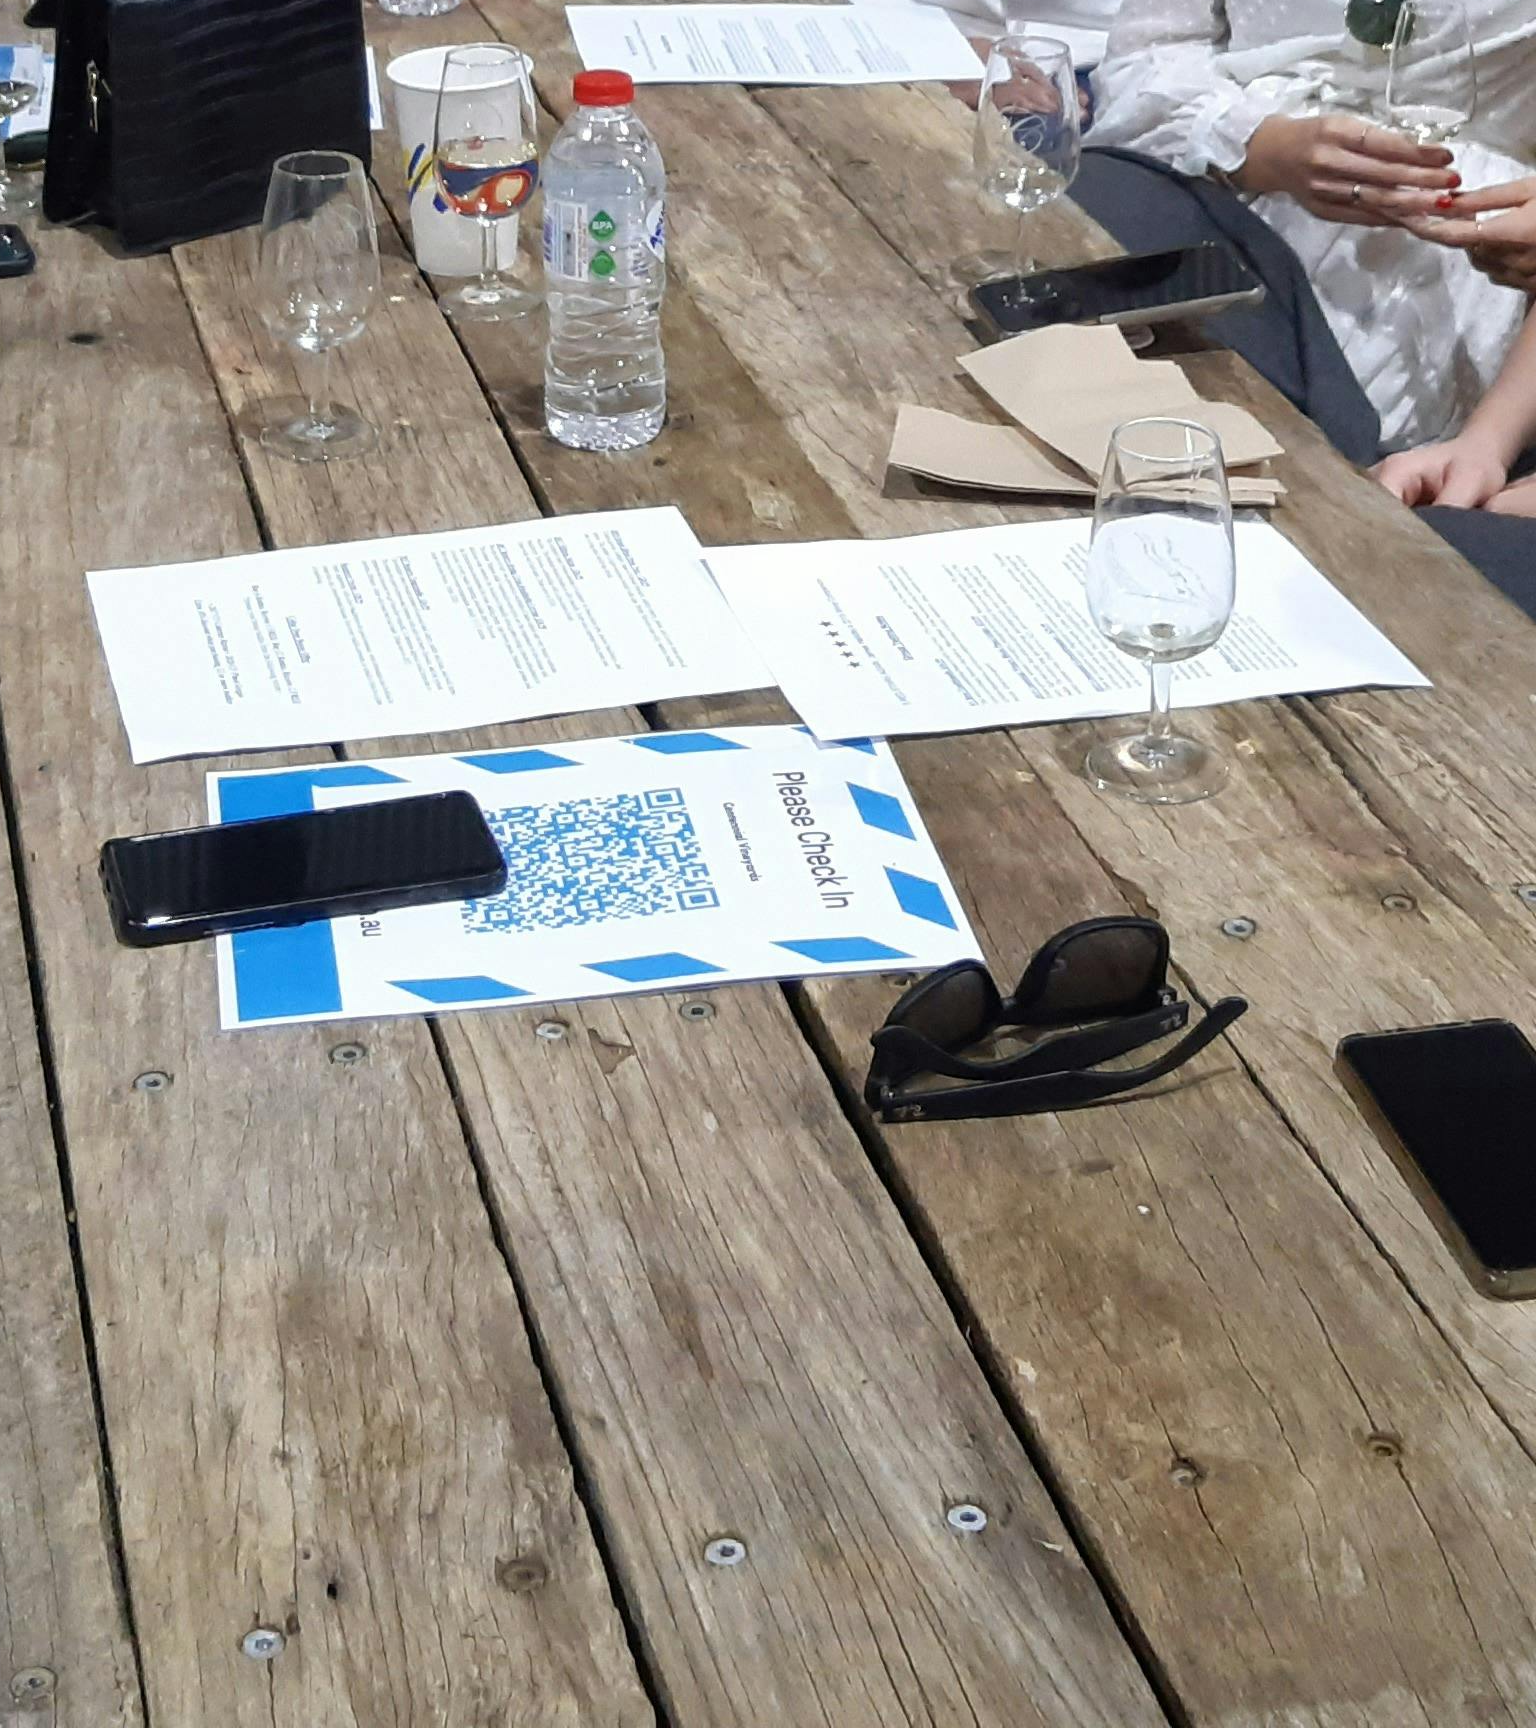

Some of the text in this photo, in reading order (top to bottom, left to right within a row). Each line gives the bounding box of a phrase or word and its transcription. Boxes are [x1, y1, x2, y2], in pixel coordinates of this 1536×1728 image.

[591, 220, 614, 232] BPA
[772, 771, 854, 909] Please Check In
